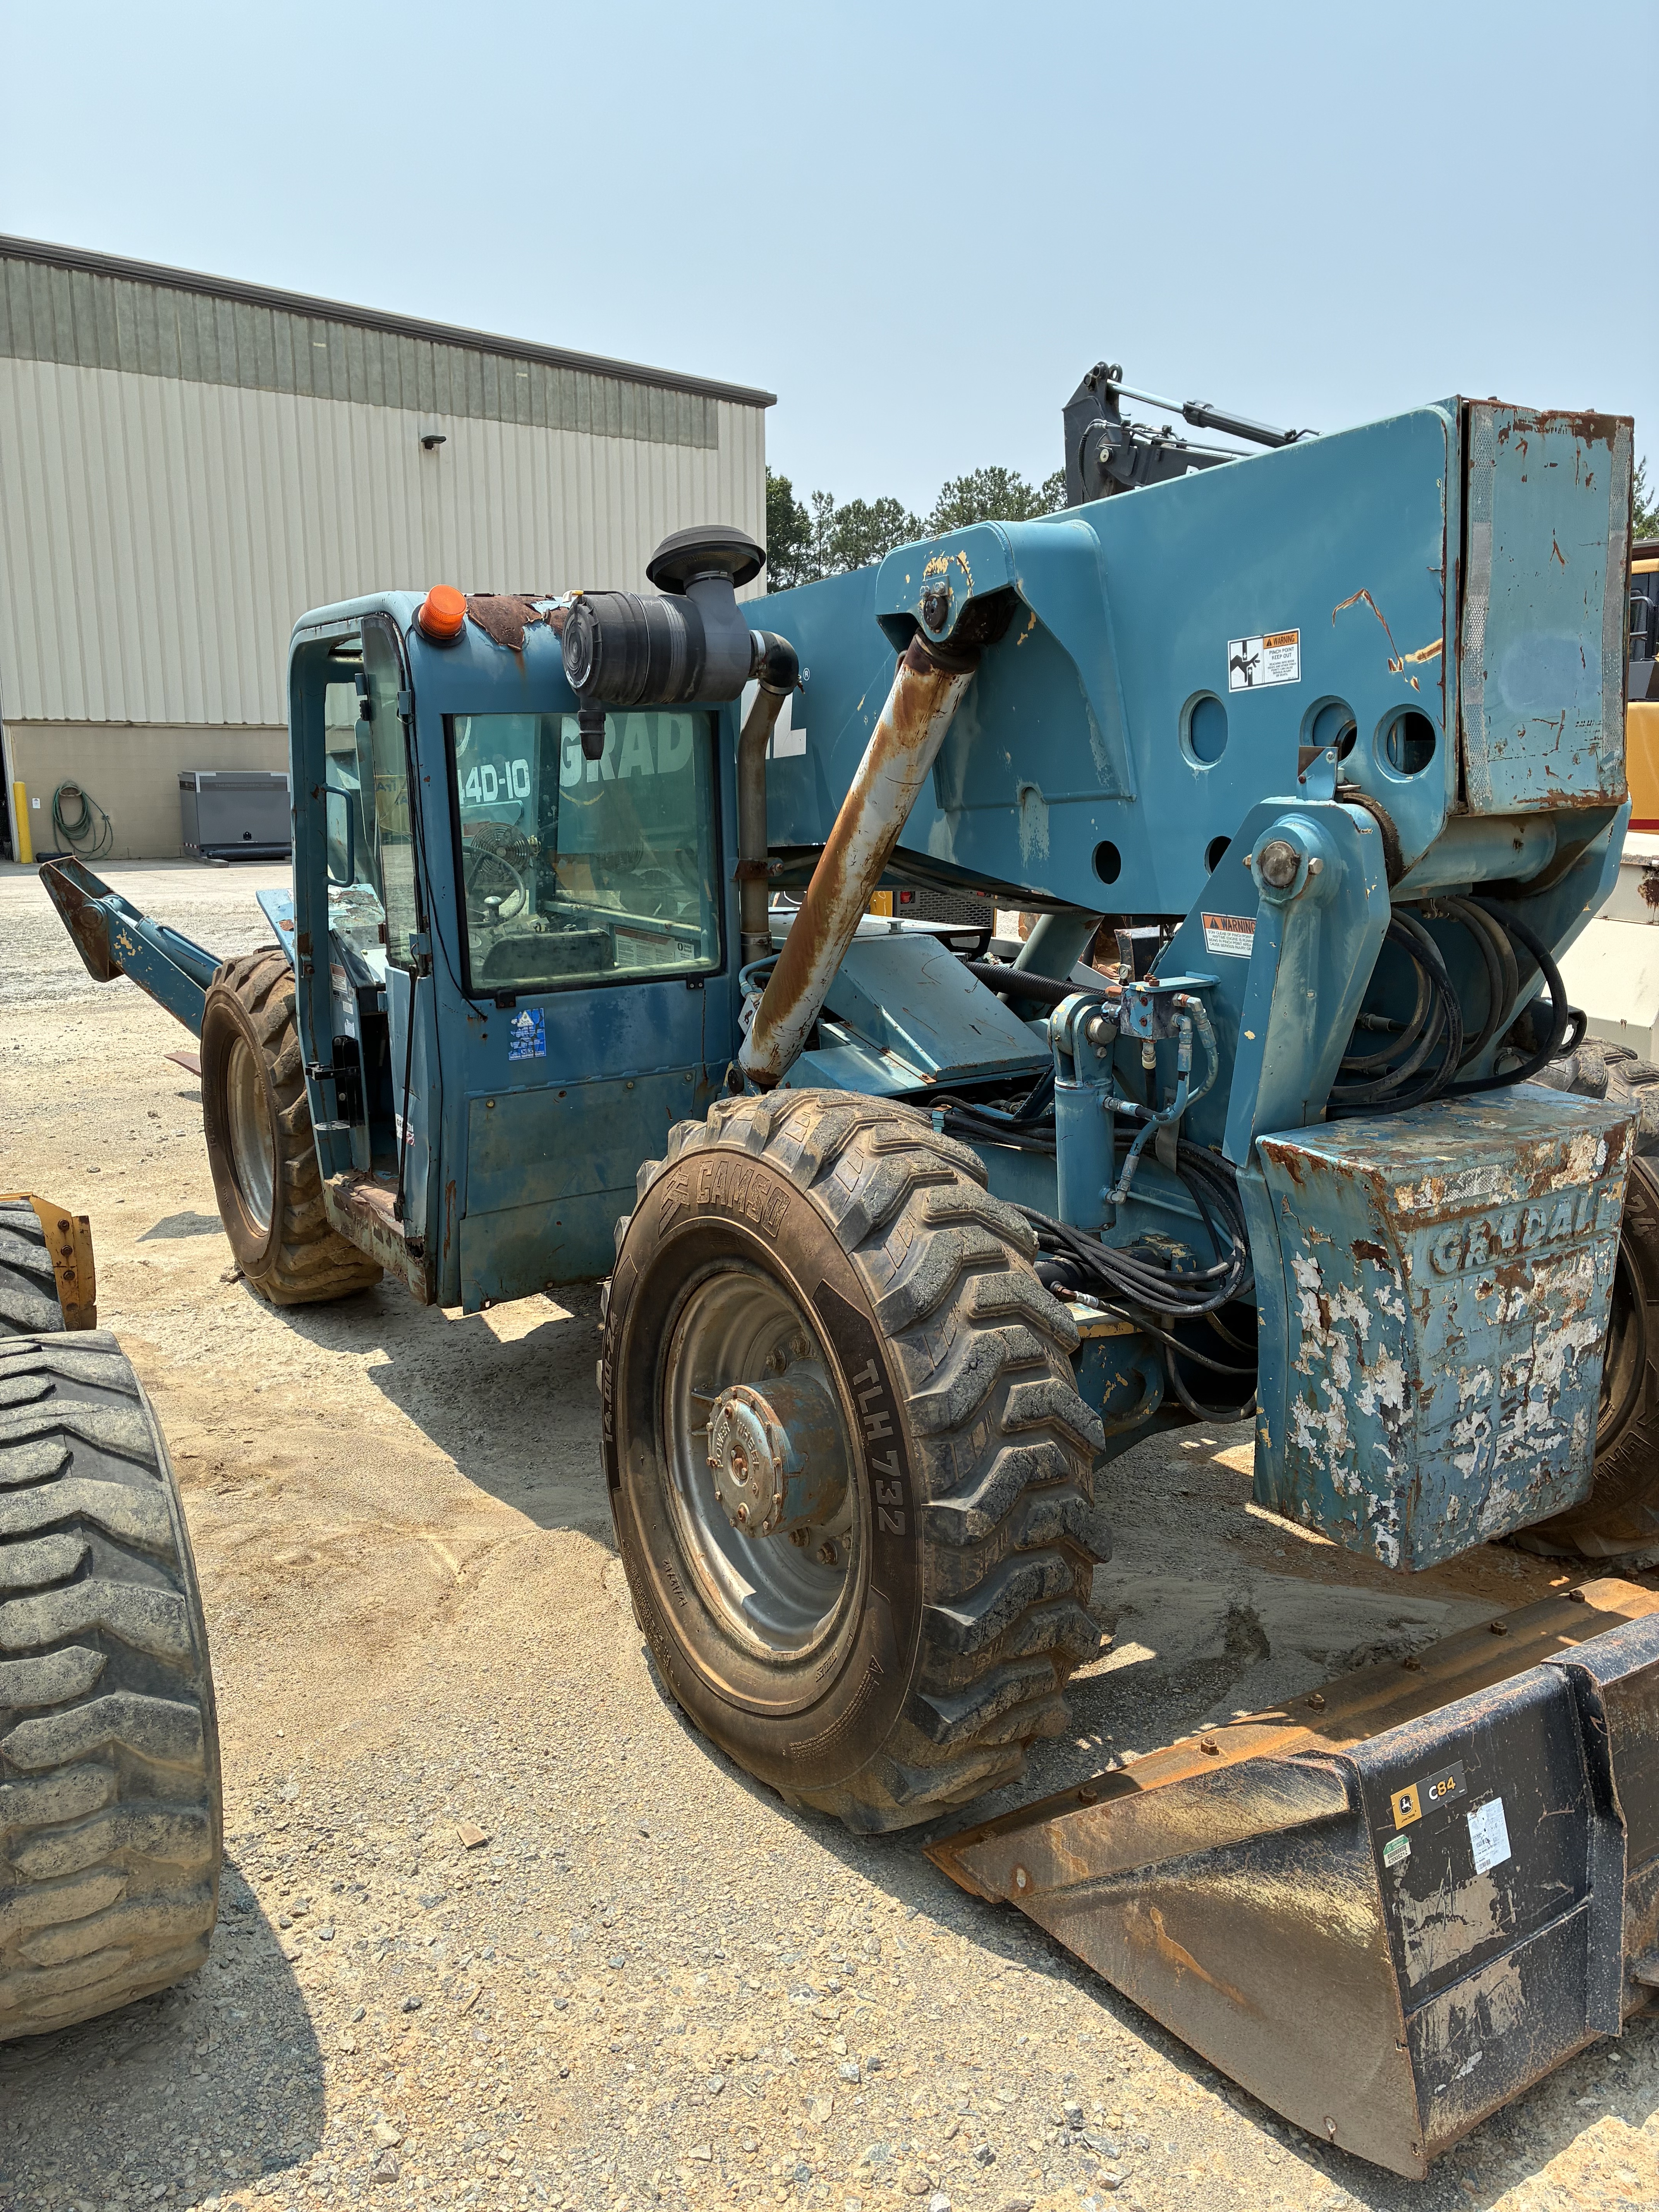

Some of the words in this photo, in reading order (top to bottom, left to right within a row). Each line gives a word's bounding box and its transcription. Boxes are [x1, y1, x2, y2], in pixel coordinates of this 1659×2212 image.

[1273, 634, 1295, 645] WARNING
[1221, 918, 1255, 933] WARNING
[697, 1160, 791, 1238] CAMSO
[604, 1310, 618, 1442] 14.00-24
[852, 1359, 893, 1441] TLH
[716, 1421, 730, 1467] POWER
[872, 1450, 905, 1536] 732
[1429, 1776, 1456, 1800] C84
